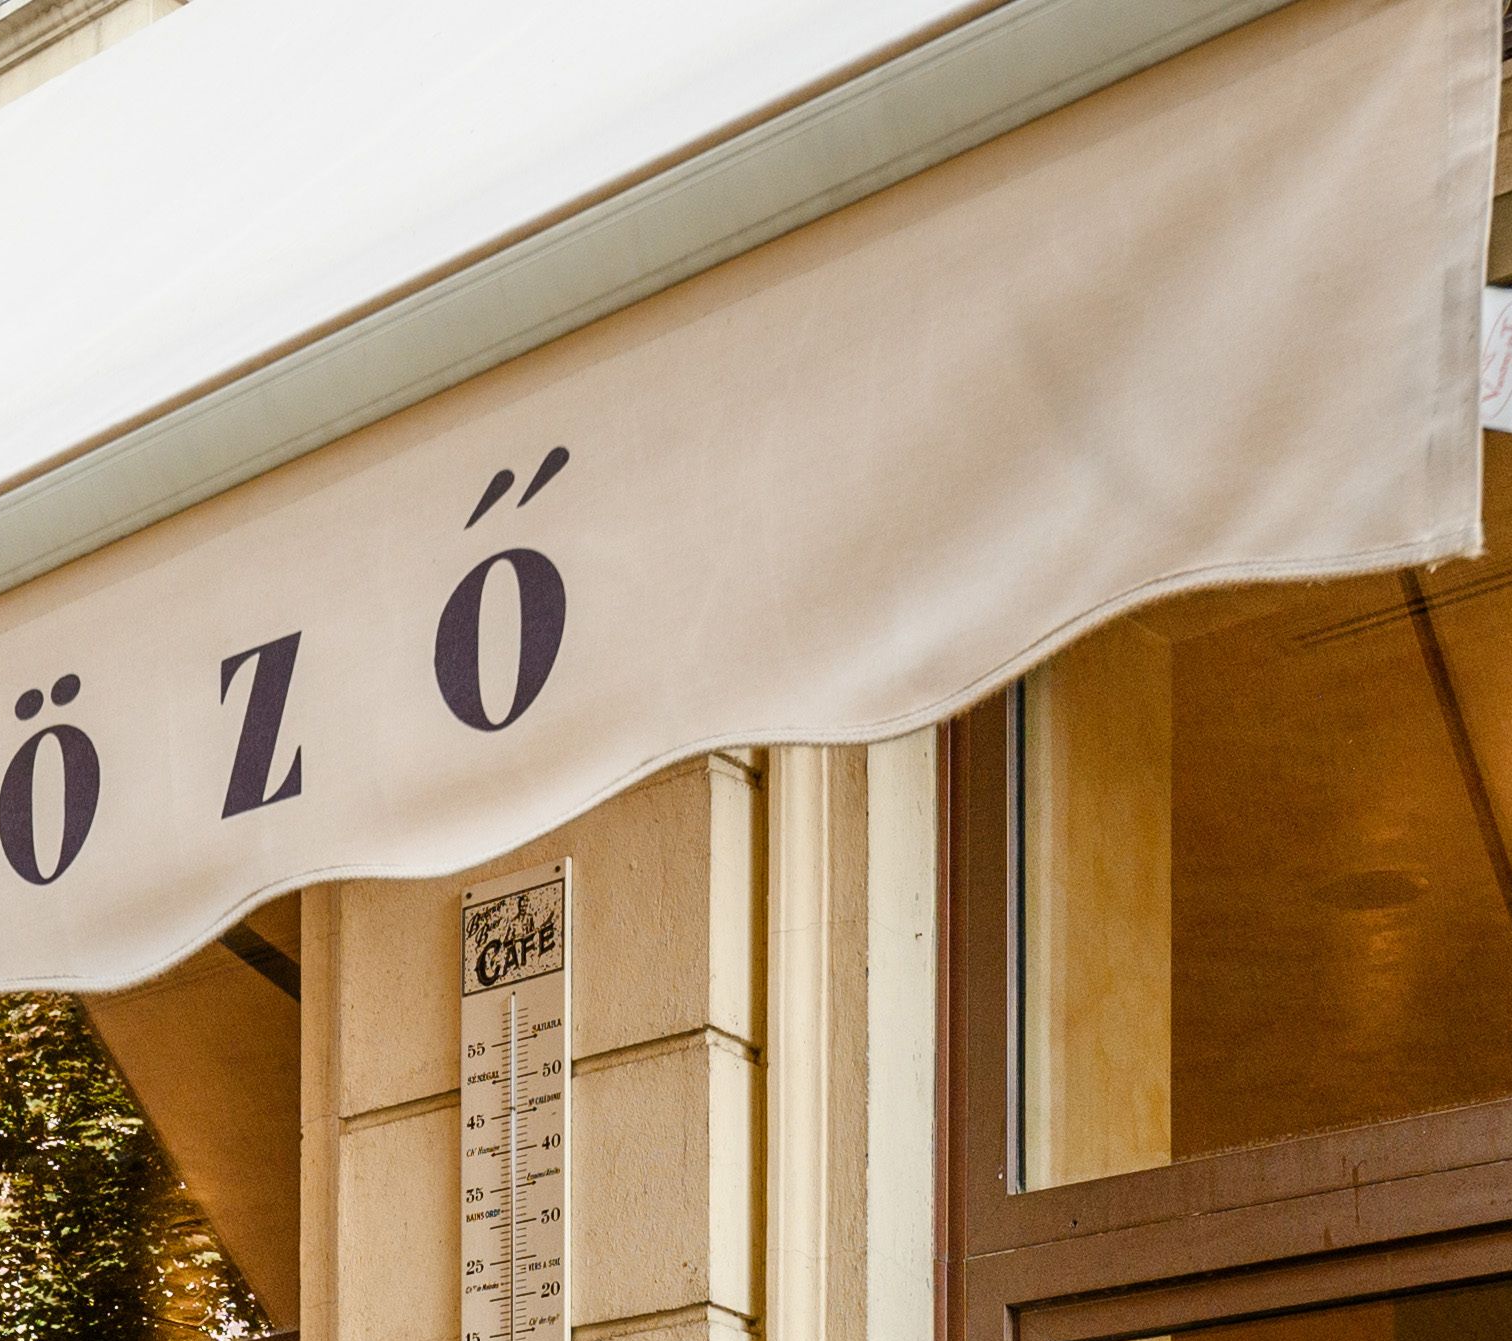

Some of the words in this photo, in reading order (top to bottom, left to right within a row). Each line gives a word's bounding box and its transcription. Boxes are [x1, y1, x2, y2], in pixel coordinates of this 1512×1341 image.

[475, 911, 556, 986] CAFÉ
[532, 1018, 562, 1033] SAHARA
[467, 1043, 486, 1059] 55
[542, 1059, 562, 1078] 50
[466, 1115, 485, 1130] 45
[542, 1134, 561, 1150] 40
[466, 1188, 484, 1203] 35
[466, 1211, 484, 1222] BAINS
[541, 1207, 560, 1224] 30
[466, 1260, 484, 1275] 25
[528, 1260, 542, 1272] VERS
[541, 1281, 560, 1298] 20
